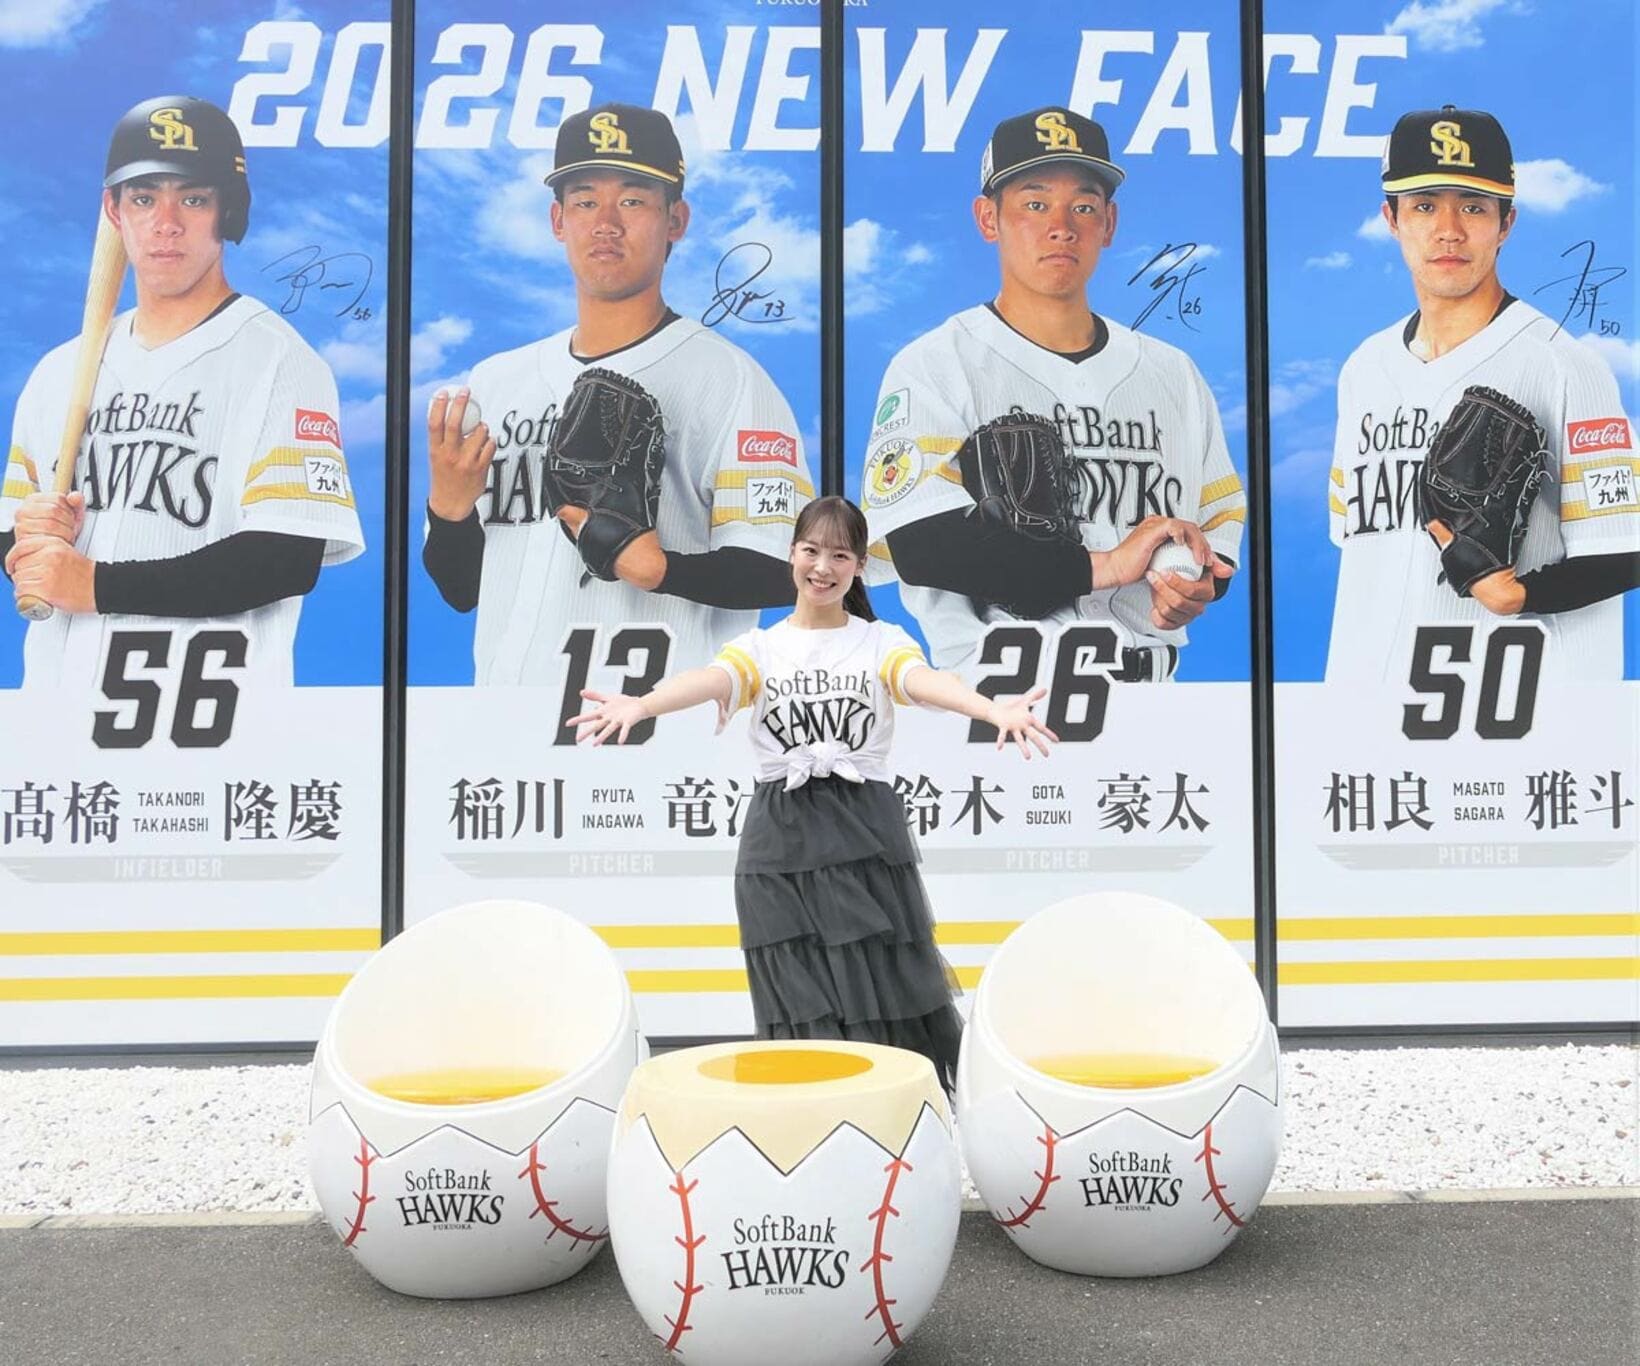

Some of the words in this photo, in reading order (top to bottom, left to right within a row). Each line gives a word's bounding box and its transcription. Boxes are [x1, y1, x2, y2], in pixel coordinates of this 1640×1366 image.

[228, 21, 604, 150] 2026
[651, 25, 1008, 153] NEW
[1067, 30, 1407, 158] FACE
[1601, 320, 1620, 335] 50
[86, 391, 202, 437] oftBank
[498, 403, 560, 449] Soft
[1054, 403, 1162, 457] ftBank
[1358, 405, 1441, 455] SoftBa
[1572, 423, 1626, 449] Coca-Cola
[72, 440, 218, 528] AWKS
[1598, 487, 1630, 505] 九州
[758, 498, 788, 513] 九州
[92, 630, 249, 749] 56
[552, 628, 672, 746] 13
[765, 668, 871, 702] SoftBank
[967, 626, 1118, 743] 26
[1402, 626, 1545, 740] 50
[761, 697, 876, 755] HAWKS
[138, 792, 205, 807] TAKANORI
[592, 788, 635, 803] RYUTA
[893, 774, 1005, 836] 鈴木
[1097, 772, 1211, 834] 豪太
[1032, 785, 1065, 800] GOTA
[1323, 771, 1435, 832] 相良
[1525, 770, 1635, 830] 雅斗
[1453, 782, 1505, 797] MASATO
[223, 779, 343, 842] 隆慶
[448, 777, 565, 840] 稲川
[582, 814, 645, 829] INAGAWA
[1026, 811, 1071, 825] SUZUKI
[1454, 807, 1505, 821] SAGARA
[132, 817, 209, 833] TAKAHASHI
[113, 857, 224, 879] INFIELDER
[568, 854, 655, 874] PITCHER
[1005, 849, 1090, 870] PITCHER
[1438, 846, 1519, 865] PITCHER
[1089, 1150, 1171, 1174] SoftBank
[404, 1168, 491, 1193] SoftBank
[1079, 1174, 1183, 1207] HAWKS
[396, 1194, 504, 1226] HAWKS
[733, 1215, 837, 1246] SoftBank
[720, 1245, 850, 1291] HAWKS
